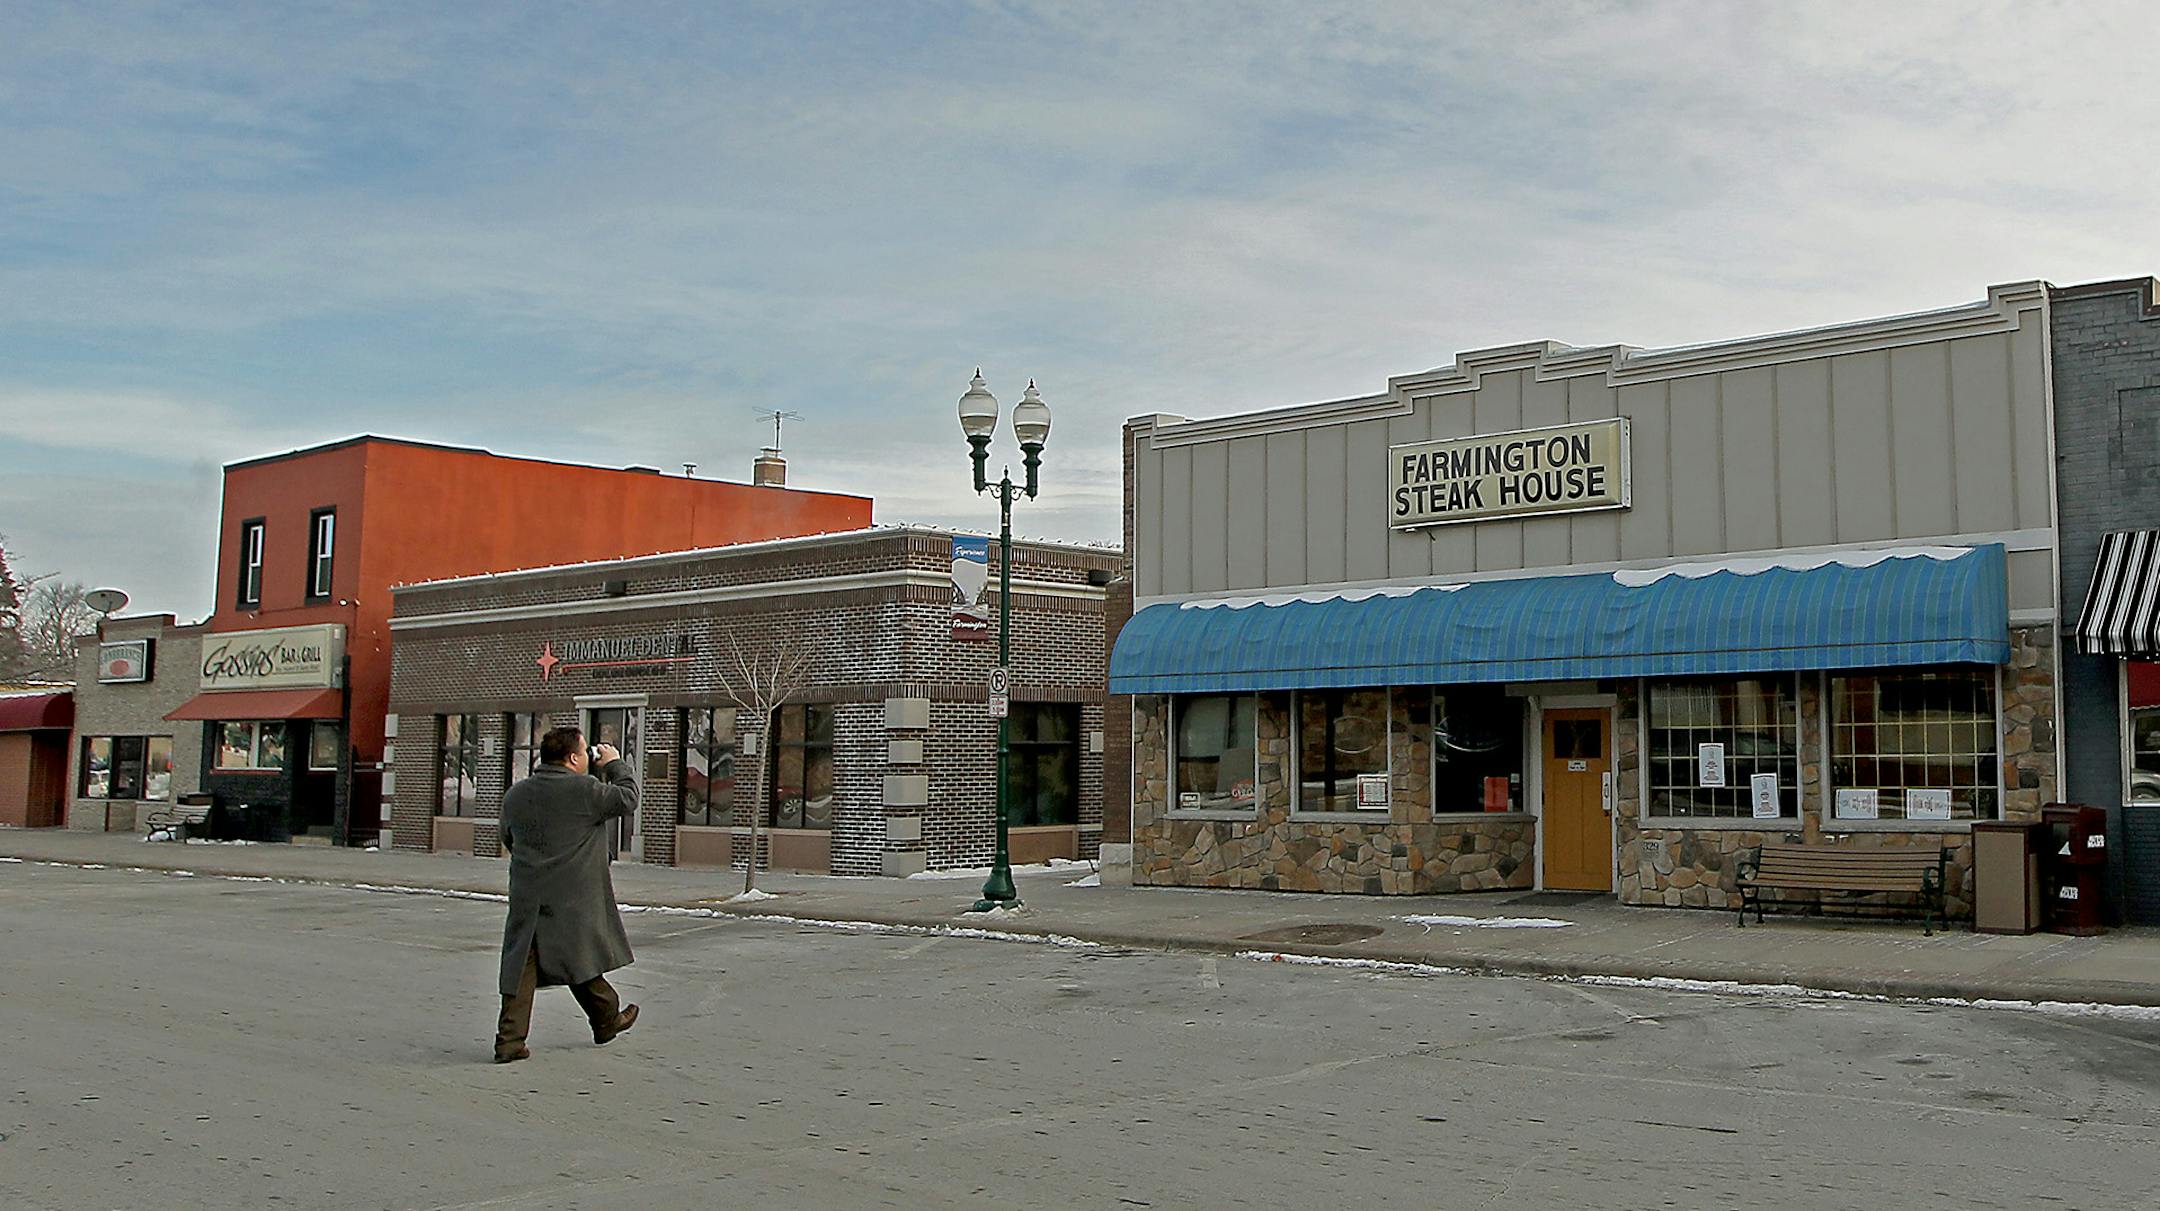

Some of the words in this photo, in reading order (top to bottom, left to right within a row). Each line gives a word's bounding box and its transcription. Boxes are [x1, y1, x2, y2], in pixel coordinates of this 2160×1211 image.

[1402, 433, 1590, 485] FARMINGTON
[1395, 478, 1484, 516] STEAK
[1500, 465, 1606, 506] HOUSE
[281, 647, 296, 663] BAR
[301, 645, 321, 662] GRILL
[563, 637, 637, 660] IMMANUEL
[638, 634, 698, 655] DENTL
